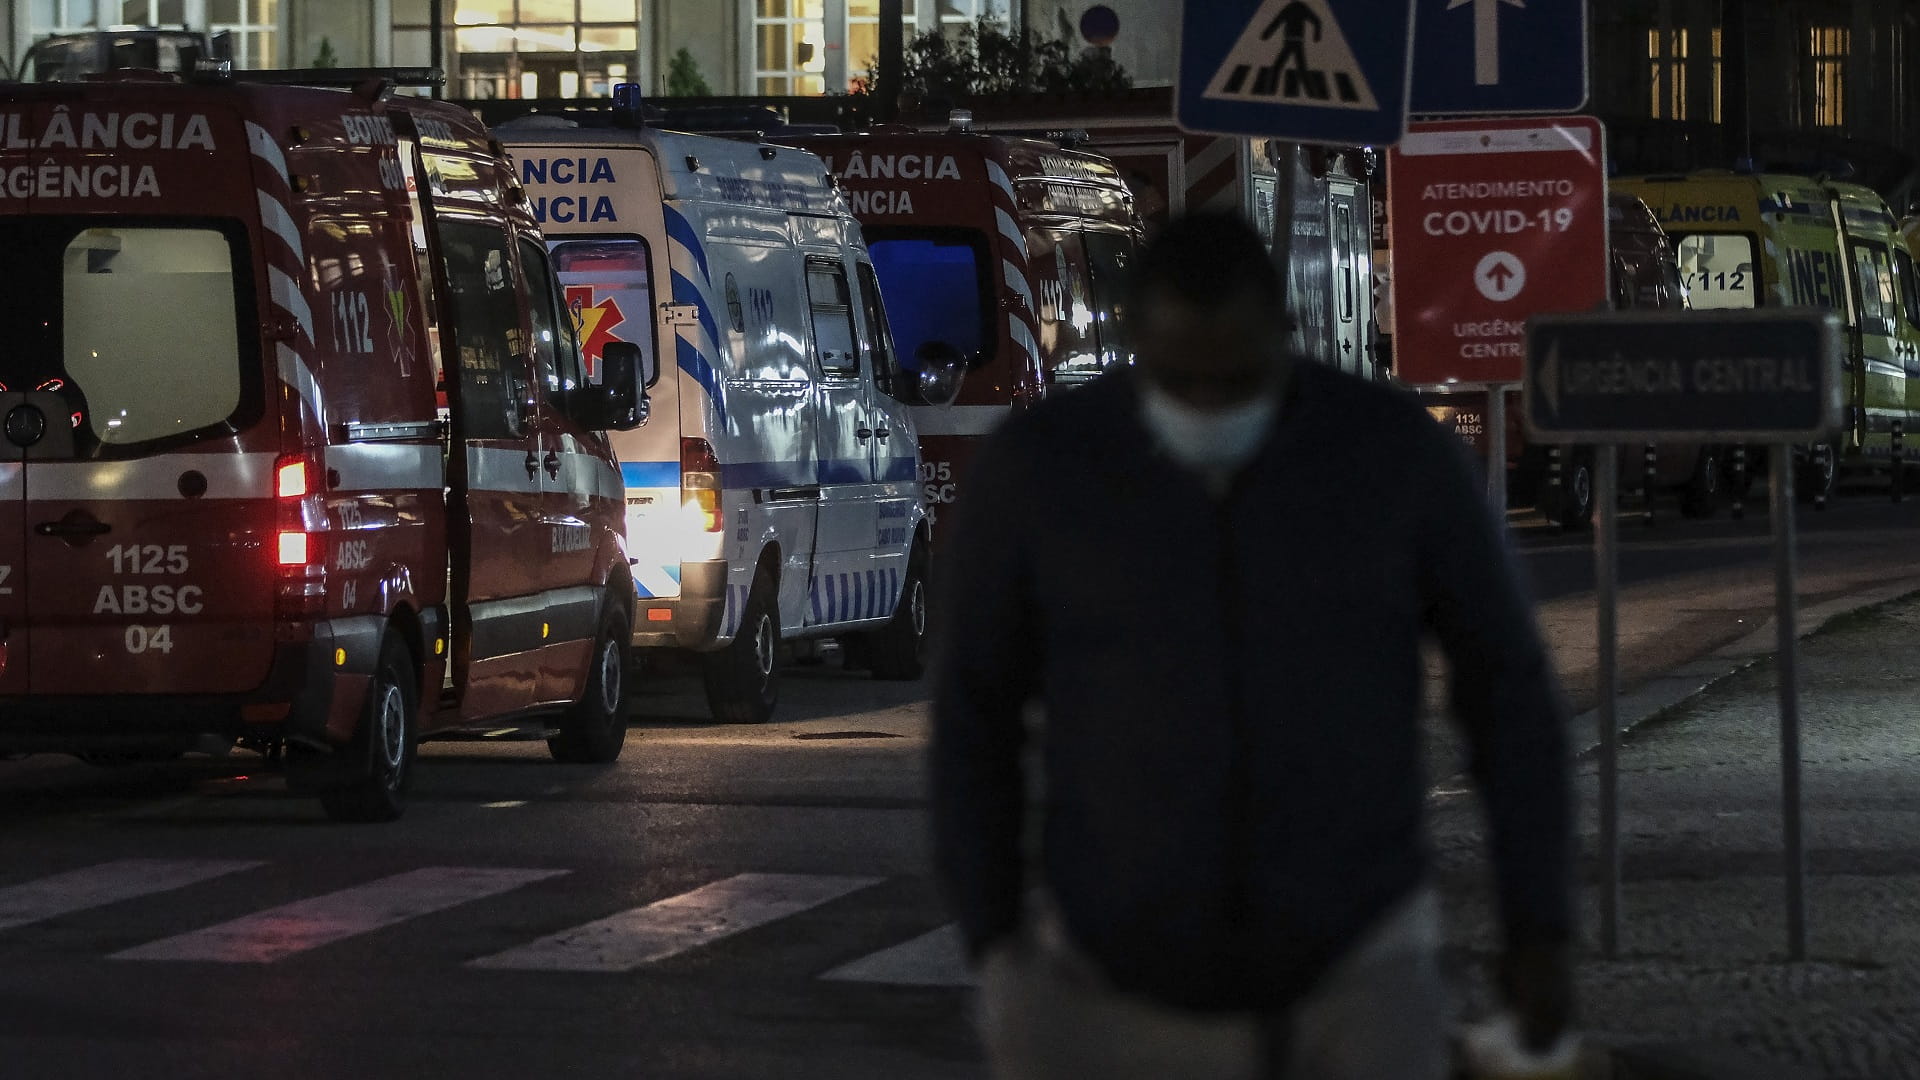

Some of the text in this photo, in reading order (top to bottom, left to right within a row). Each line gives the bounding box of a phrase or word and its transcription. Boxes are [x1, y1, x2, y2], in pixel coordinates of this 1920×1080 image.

[1422, 179, 1574, 201] ATENDIMENTO
[1423, 207, 1574, 237] COVID-19
[1698, 272, 1745, 291] 112
[338, 291, 374, 353] 112
[1460, 342, 1526, 359] CENTR
[1693, 356, 1813, 394] CENTRAL
[1455, 424, 1483, 436] ABSC
[105, 544, 189, 574] 1125
[337, 540, 367, 571] ABSC
[93, 585, 204, 615] ABSC
[125, 624, 173, 654] 04
